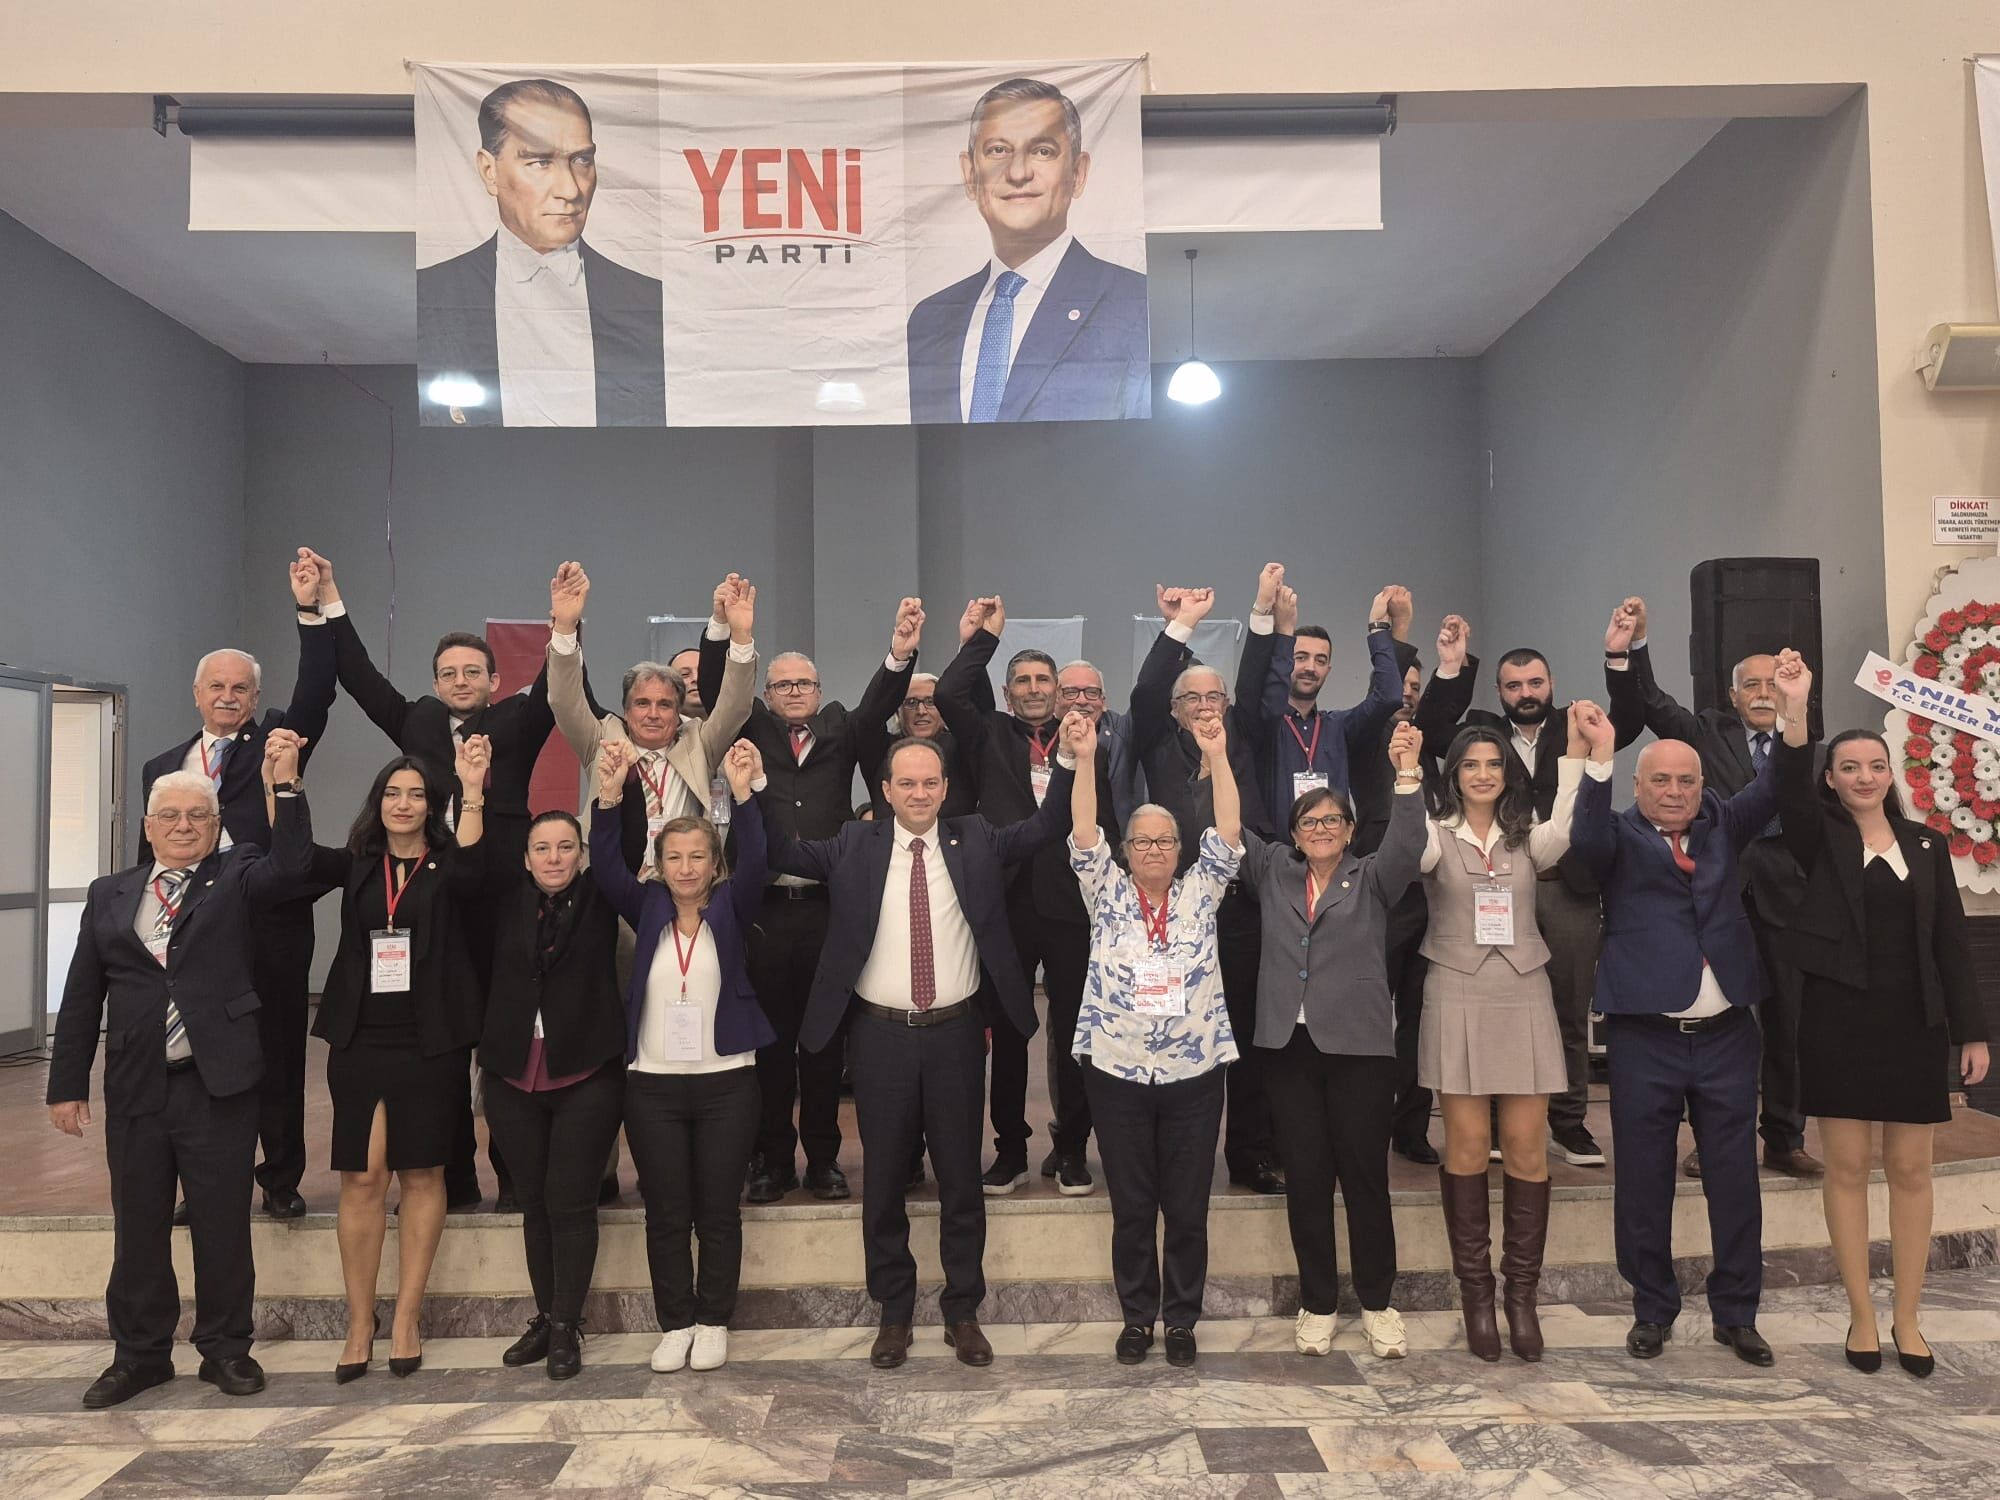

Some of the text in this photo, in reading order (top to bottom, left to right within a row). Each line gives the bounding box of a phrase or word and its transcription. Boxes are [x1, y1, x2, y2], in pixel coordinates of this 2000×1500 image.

[683, 148, 862, 235] YENİ
[715, 244, 852, 264] PARTİ
[1950, 500, 1989, 510] DİKKAT!
[1891, 688, 1915, 705] T.C.
[1919, 700, 1979, 727] EFELER
[1895, 679, 1974, 714] ANIL
